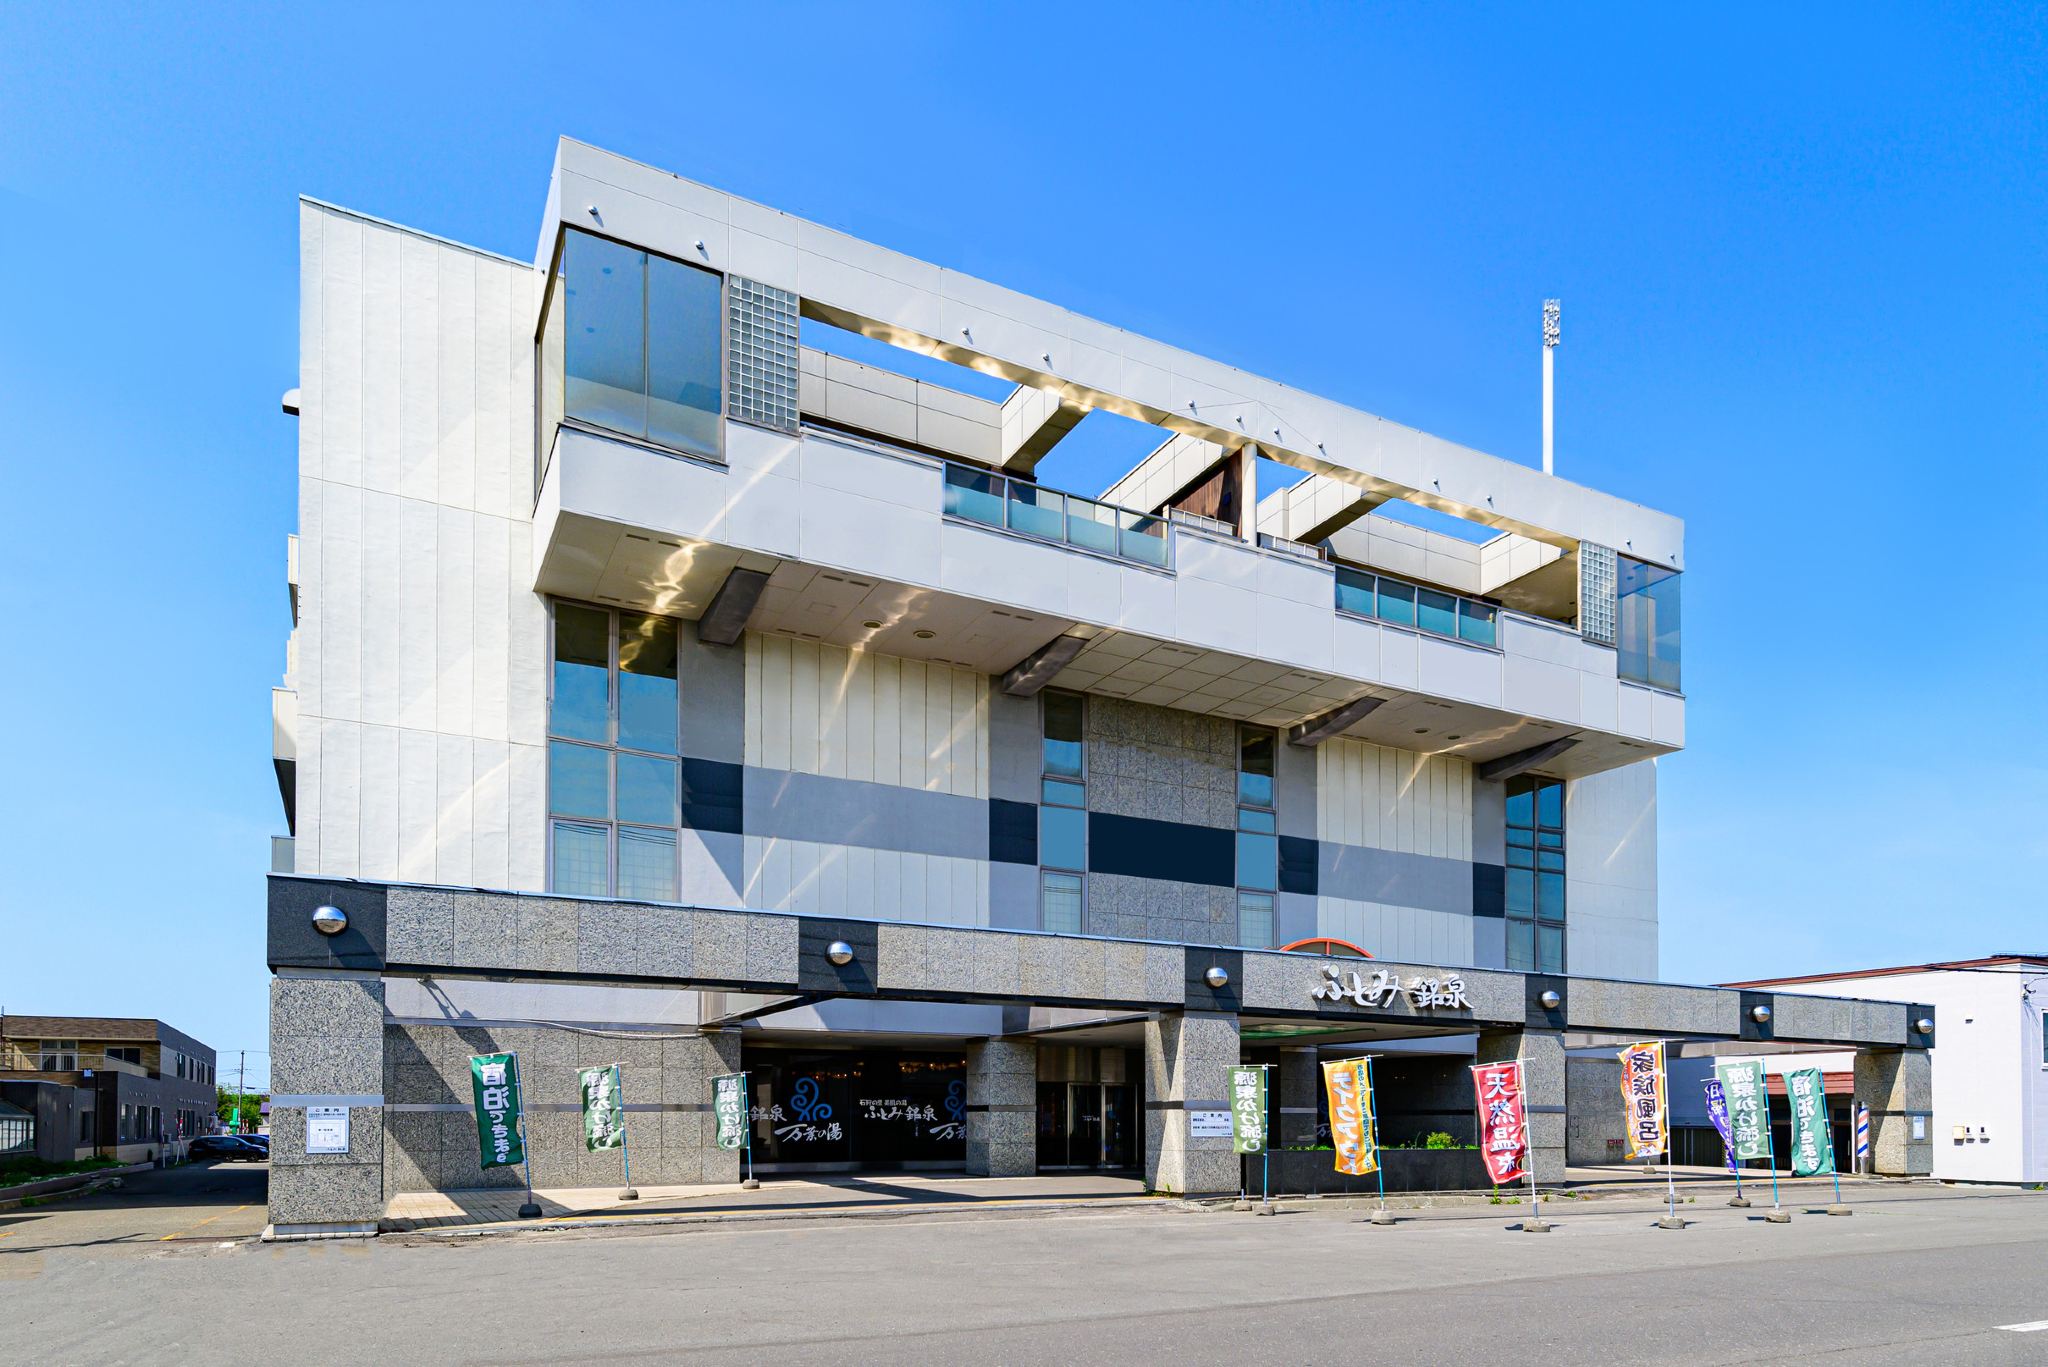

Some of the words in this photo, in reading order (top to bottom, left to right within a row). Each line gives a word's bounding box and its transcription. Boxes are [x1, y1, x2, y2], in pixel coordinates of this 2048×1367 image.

[1312, 964, 1475, 1009] ふとみ銘泉
[774, 1122, 843, 1142] 万葉の湯
